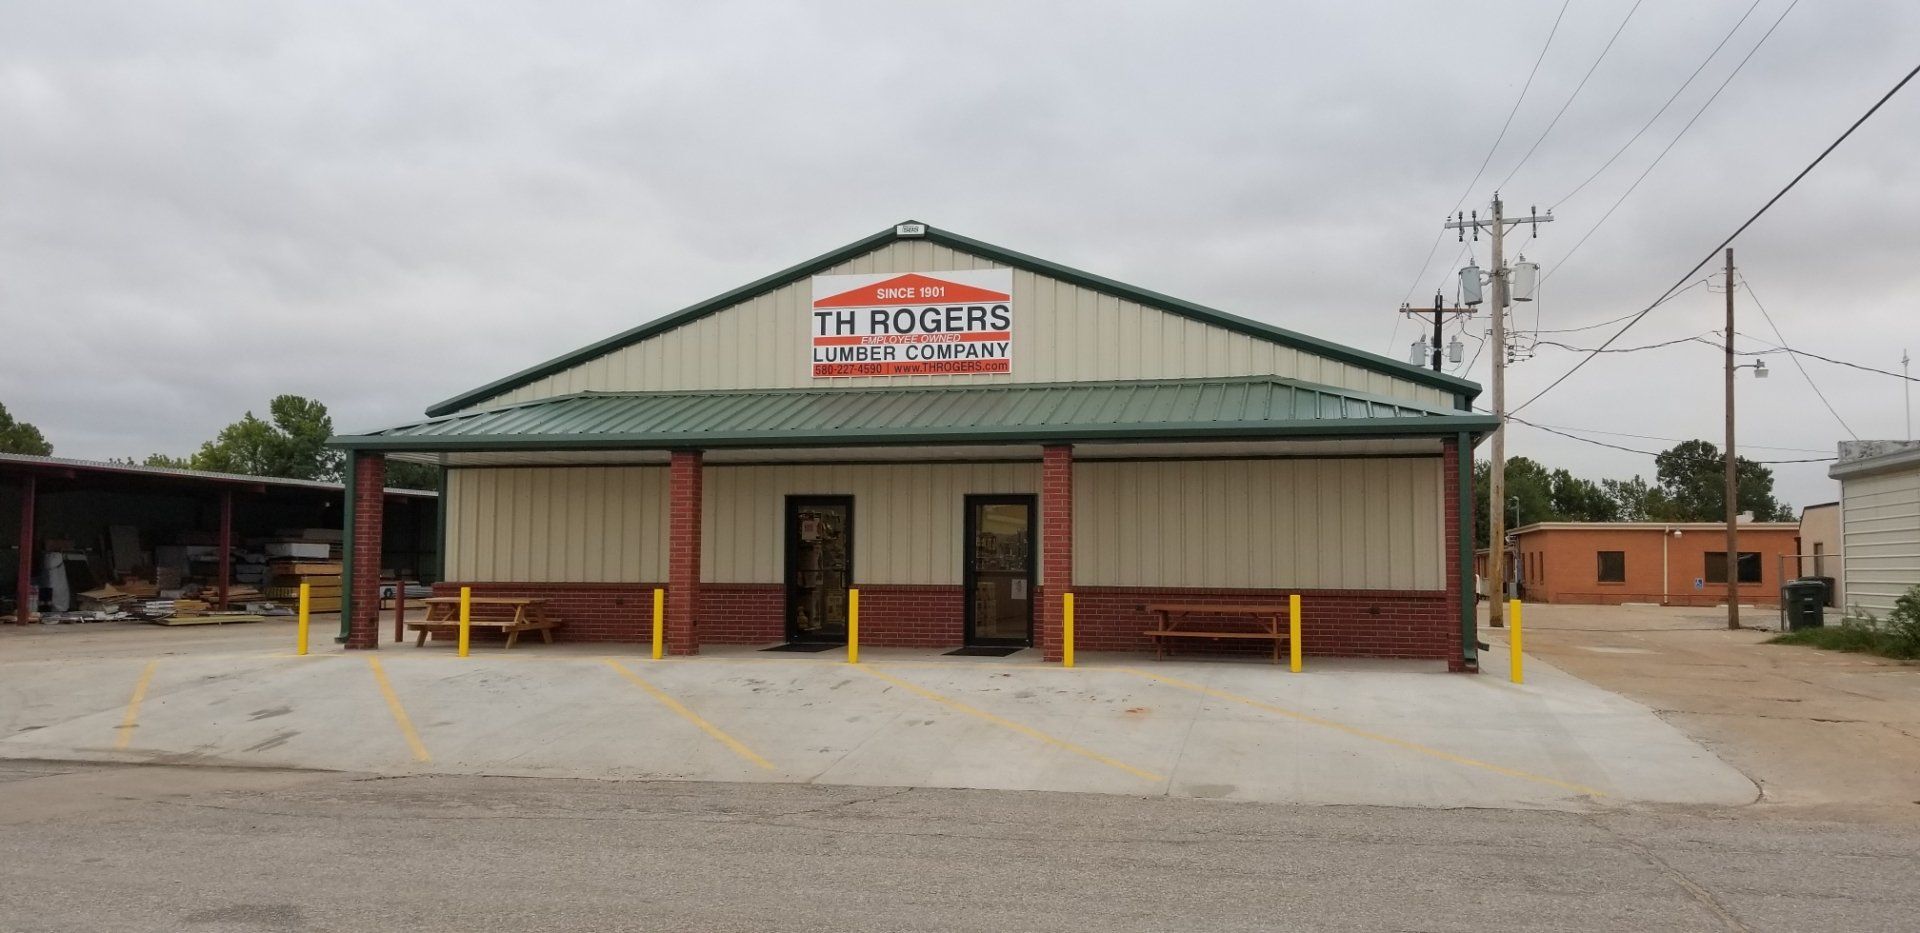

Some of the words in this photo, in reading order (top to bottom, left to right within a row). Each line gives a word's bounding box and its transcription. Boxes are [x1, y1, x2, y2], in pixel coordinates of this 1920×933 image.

[877, 288, 915, 299] SINCE
[920, 287, 945, 298] 1901
[814, 311, 855, 335] TH
[870, 304, 1010, 334] ROGERS
[861, 334, 918, 344] EMPLOYEE
[921, 333, 961, 343] OWNED
[814, 345, 896, 362] LUMBER
[906, 342, 1009, 361] COMPANY
[815, 364, 882, 375] 580-227-4590
[894, 361, 1008, 374] www.THROGERS.com
